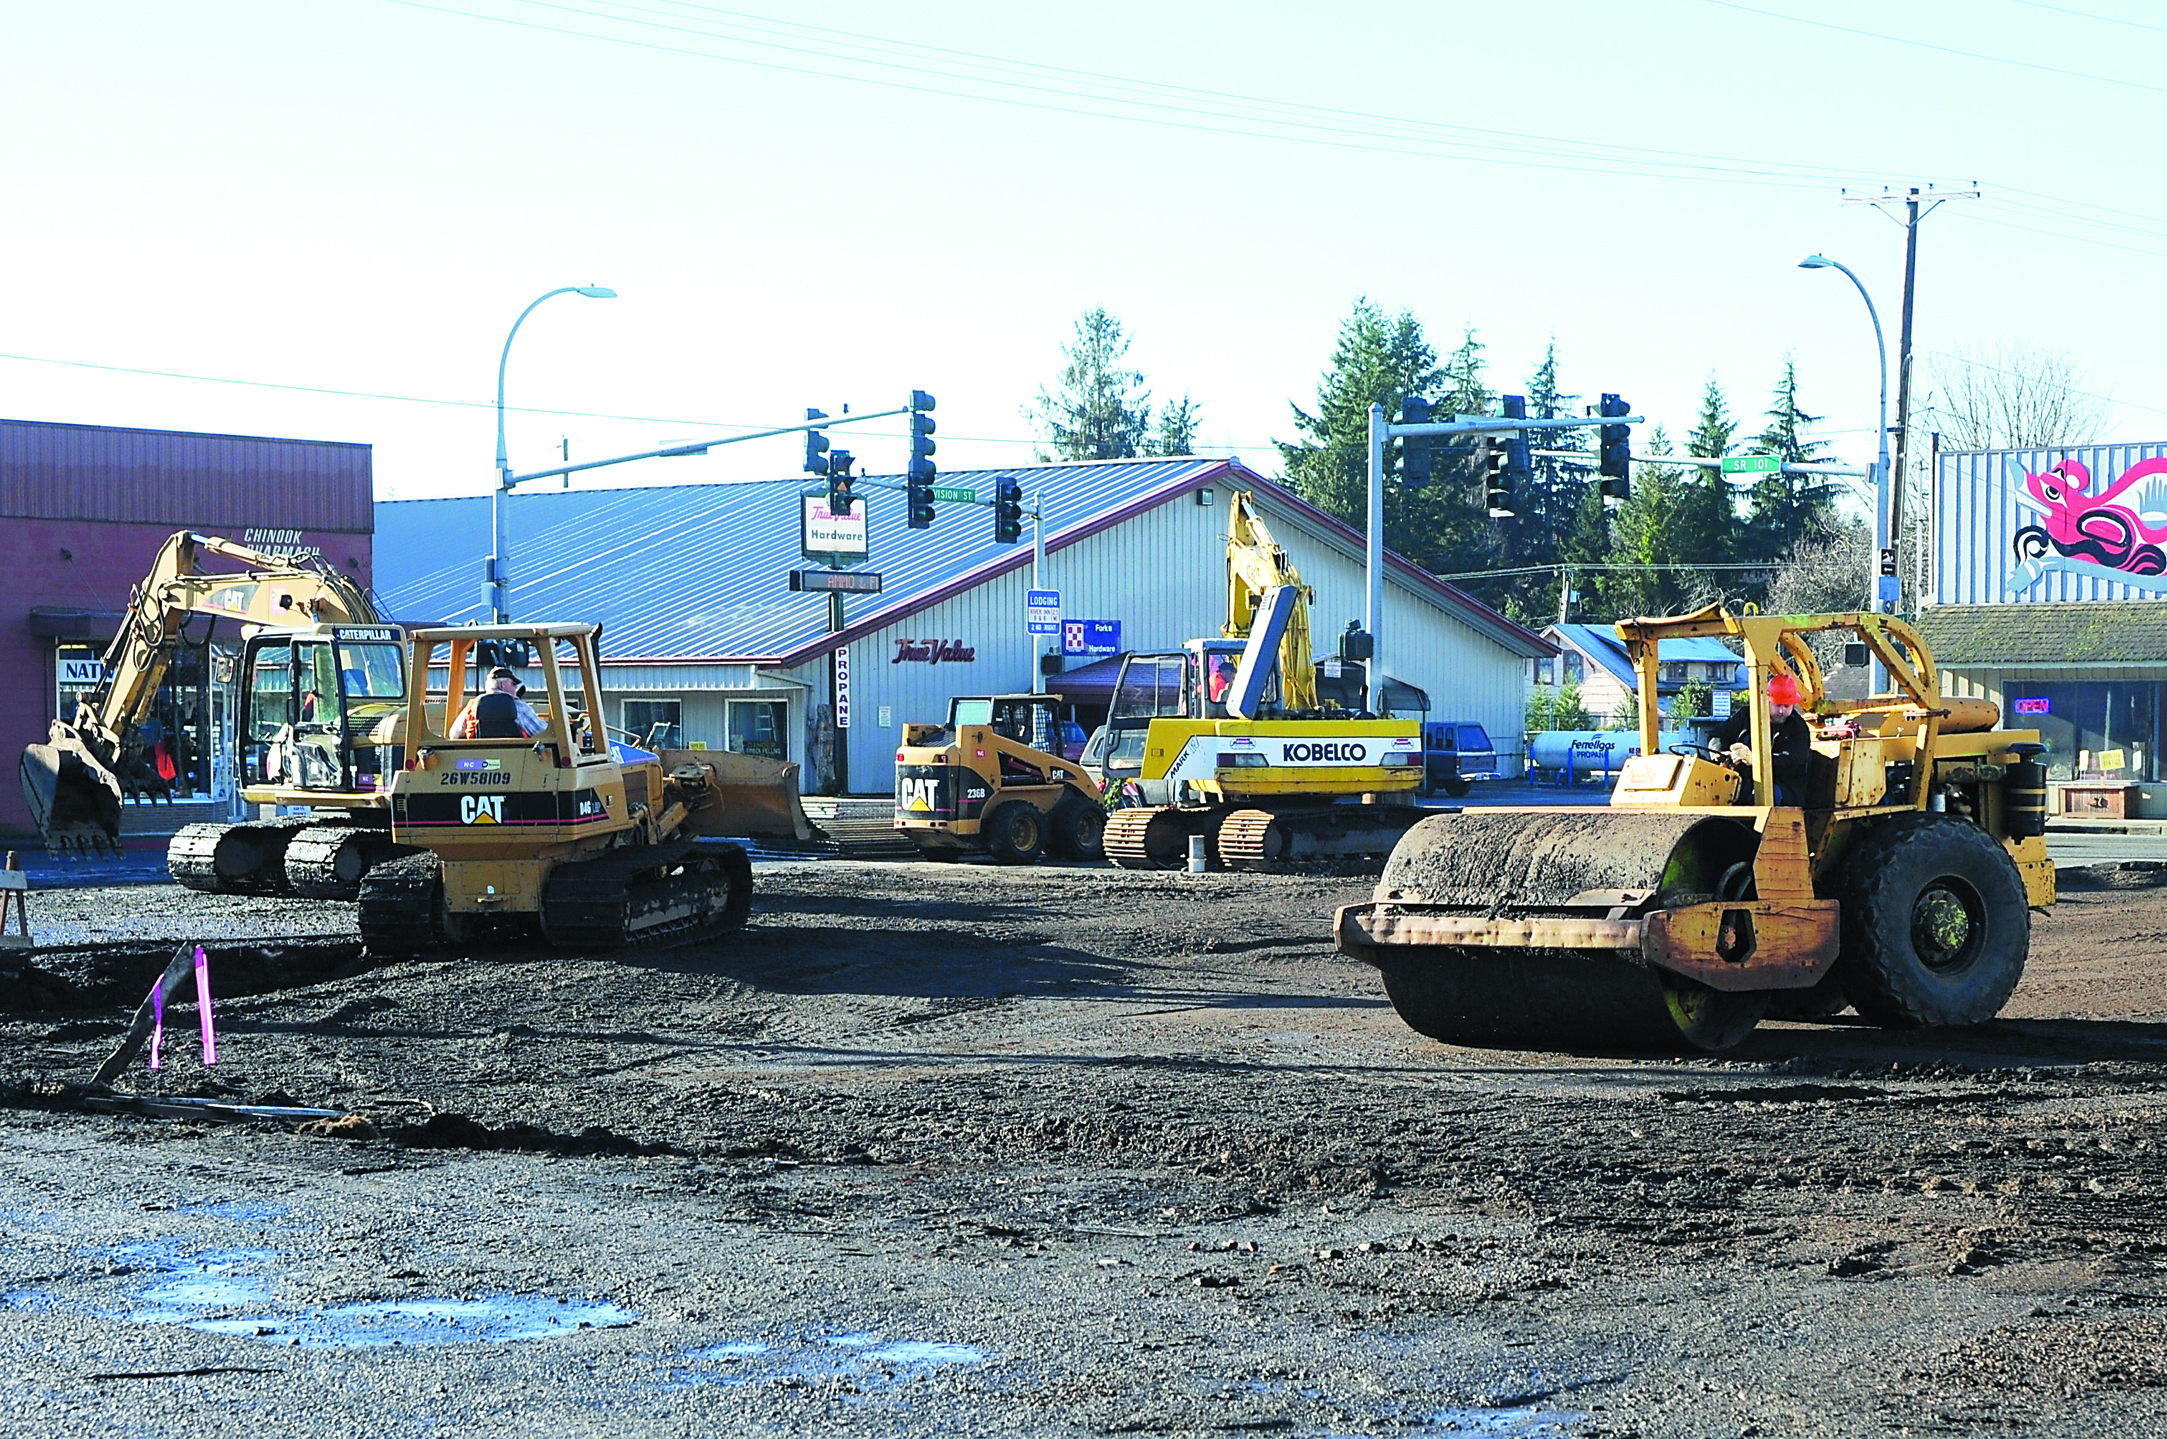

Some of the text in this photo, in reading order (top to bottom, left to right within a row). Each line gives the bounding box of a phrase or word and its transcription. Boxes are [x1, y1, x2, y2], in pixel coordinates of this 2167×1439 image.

[1733, 459, 1768, 471] SR 101
[933, 489, 958, 500] VISION
[243, 528, 302, 544] CHINOOK
[811, 529, 863, 541] Hardware
[224, 590, 244, 611] CAT
[1030, 596, 1058, 606] LODGING
[1095, 623, 1112, 632] Forks
[339, 629, 391, 640] CATERPILLAR
[1088, 645, 1116, 653] Hardware
[838, 649, 848, 726] PROPANE
[2018, 699, 2048, 712] OPEN
[1571, 738, 1616, 752] Ferrellgas
[1283, 743, 1366, 761] KOBELCO
[1577, 751, 1606, 759] PROPAN
[1170, 750, 1190, 779] MARK
[441, 772, 511, 785] 26W58109
[1052, 769, 1064, 779] CAT
[902, 777, 940, 812] CAT
[967, 788, 985, 798] 236B
[461, 795, 504, 824] CAT
